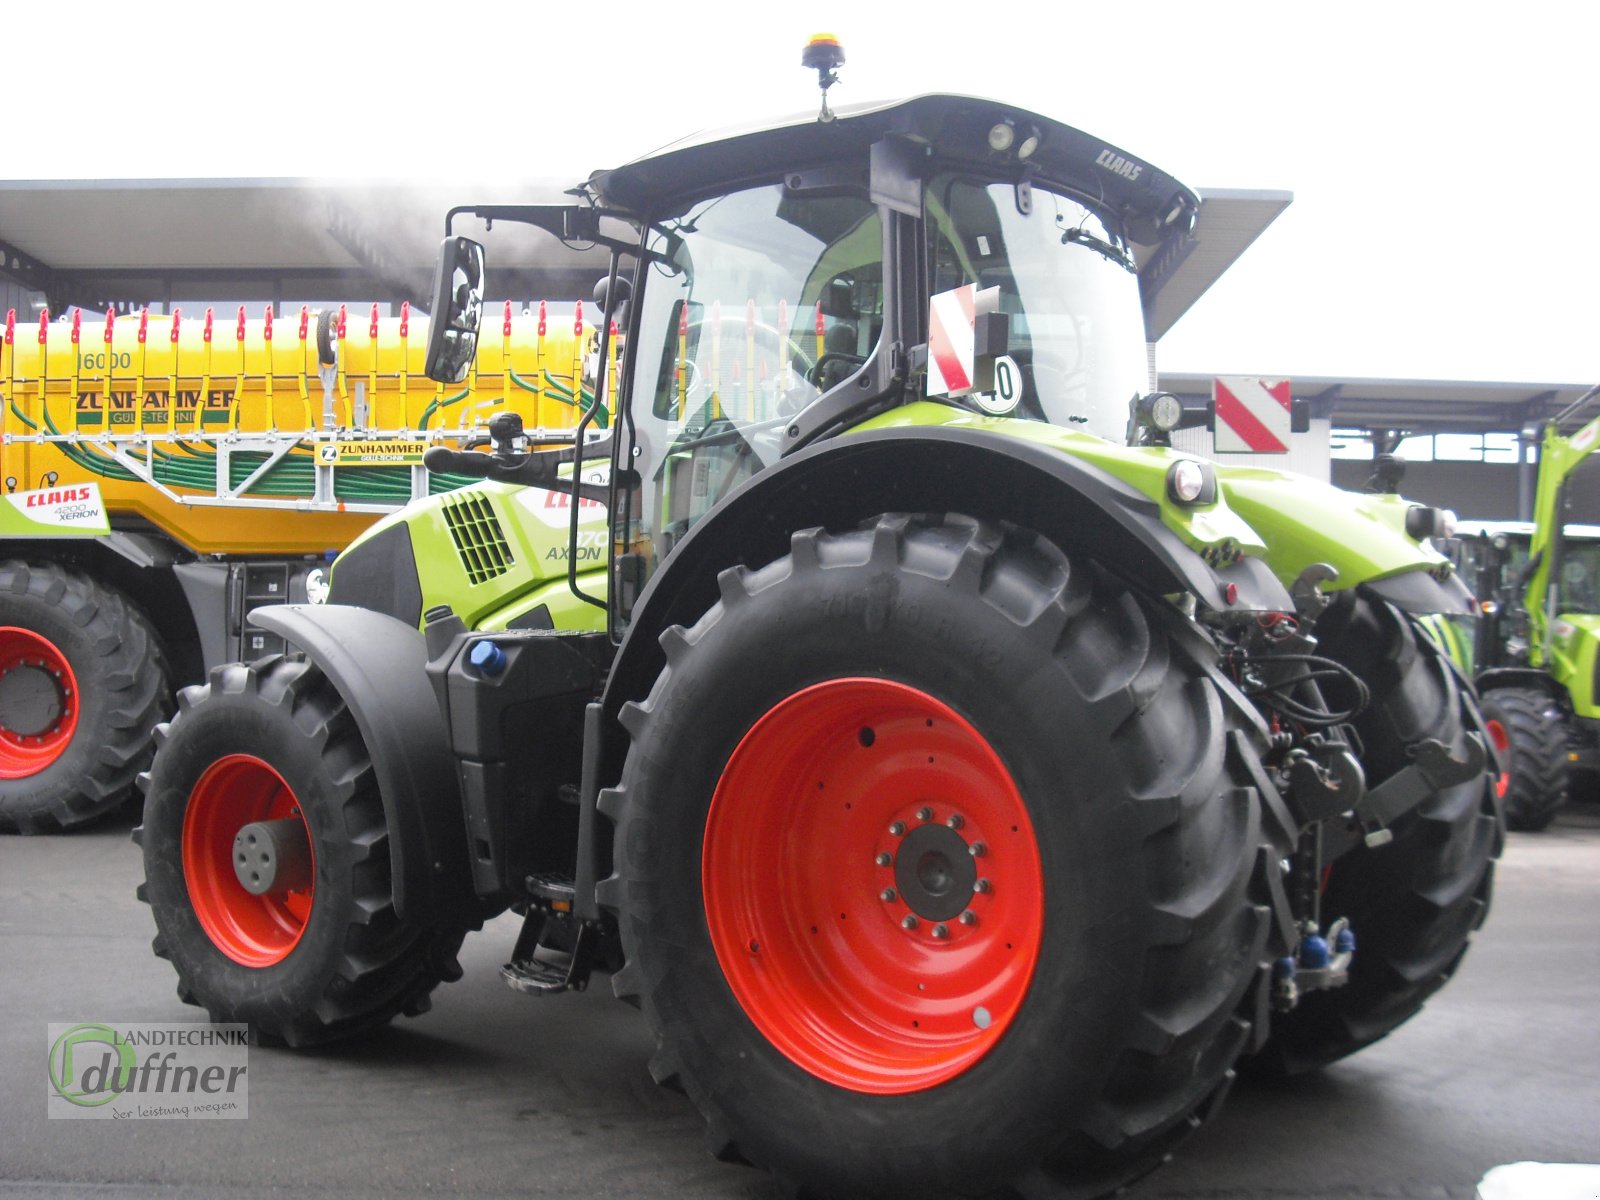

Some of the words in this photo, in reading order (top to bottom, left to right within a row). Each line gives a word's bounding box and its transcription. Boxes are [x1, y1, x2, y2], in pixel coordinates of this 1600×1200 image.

[1095, 149, 1143, 181] CLAAS
[340, 444, 424, 455] ZUNHAMMER
[26, 487, 91, 508] CLAAS
[54, 503, 87, 515] 4200
[59, 509, 99, 522] XERION
[545, 547, 602, 561] AXON
